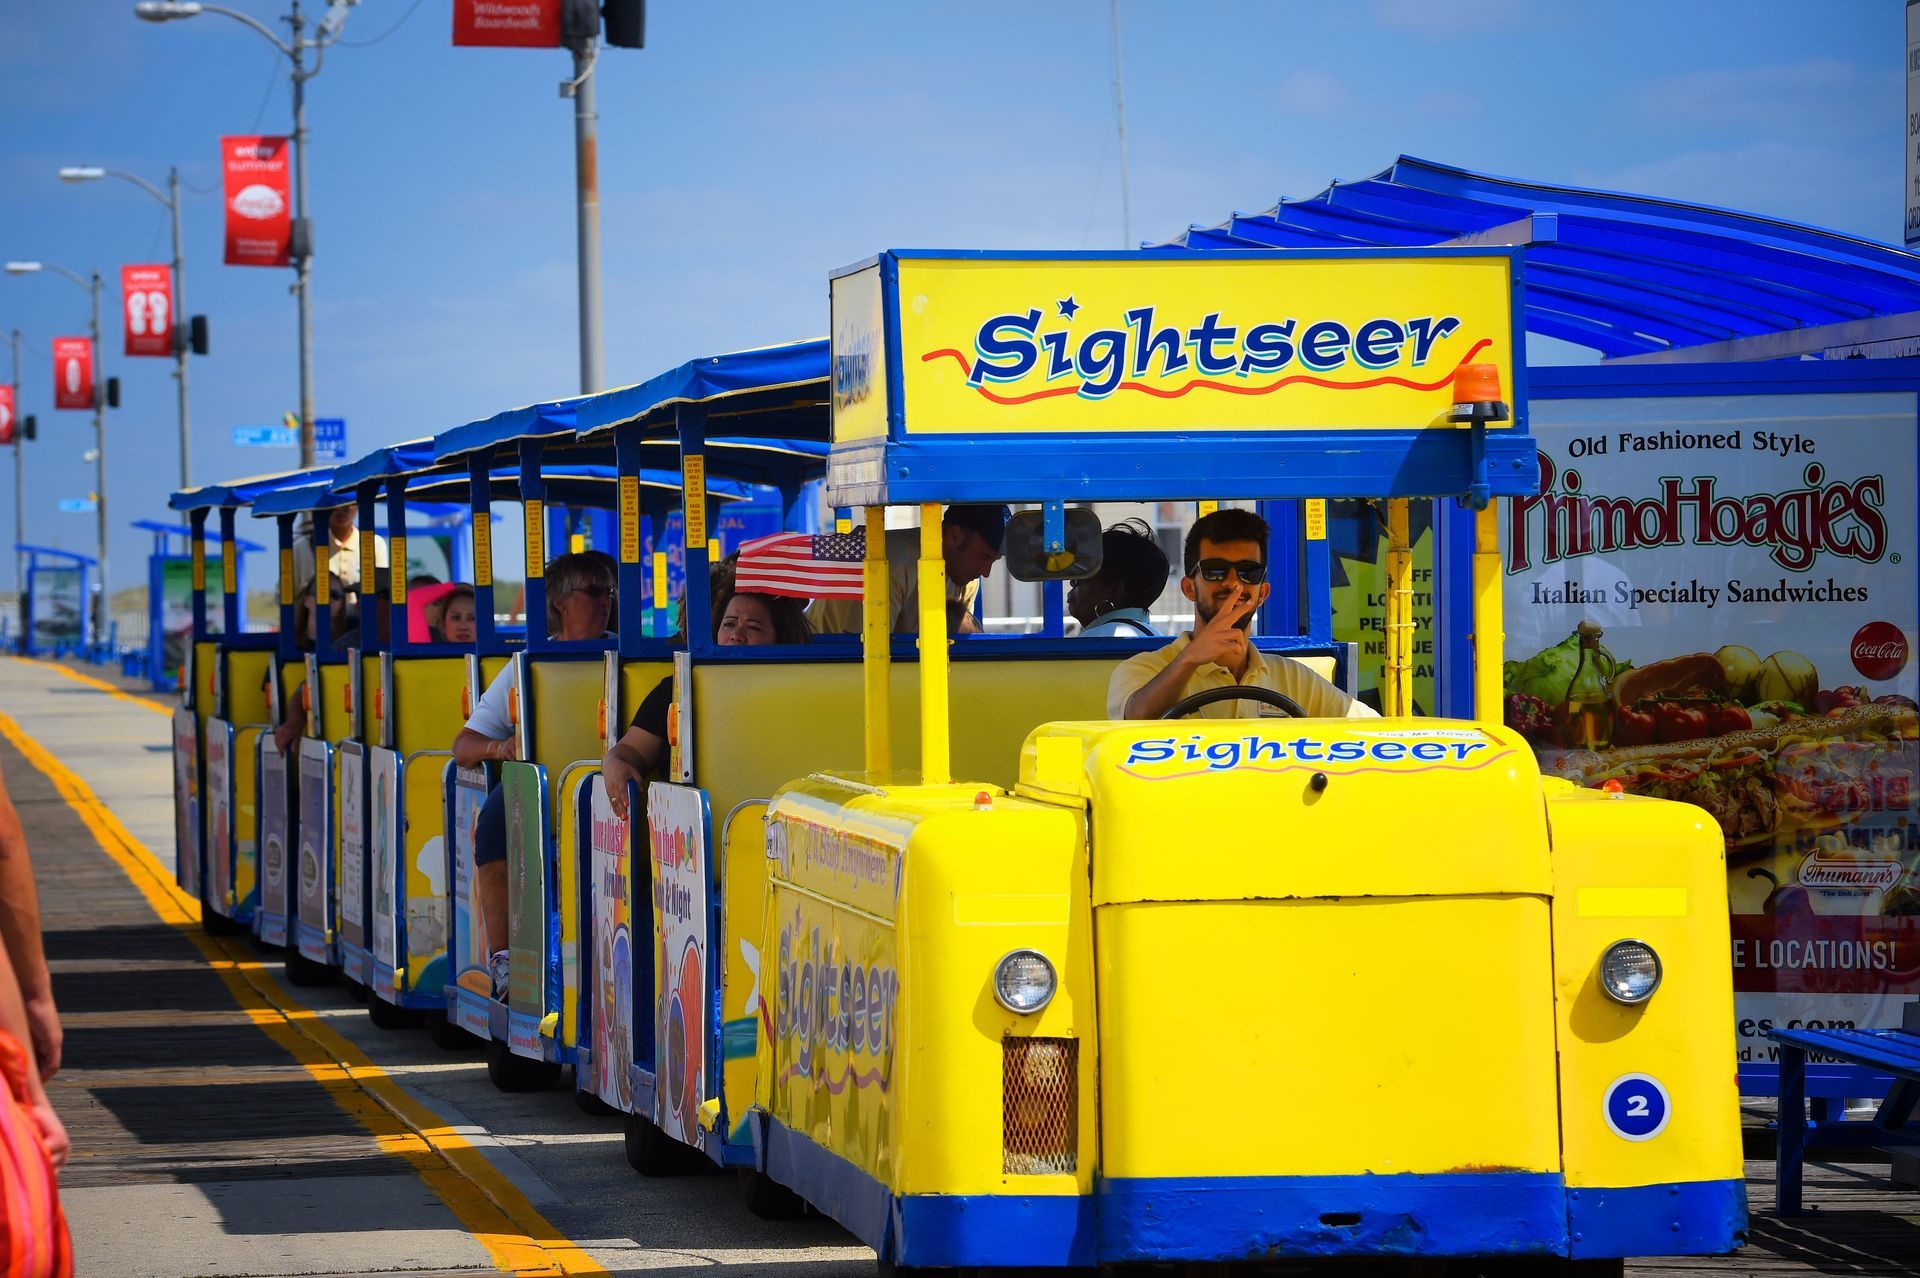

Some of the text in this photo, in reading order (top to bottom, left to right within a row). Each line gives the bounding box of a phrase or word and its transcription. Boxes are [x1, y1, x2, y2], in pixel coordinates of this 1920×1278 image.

[966, 296, 1461, 401] Sightseer
[1568, 430, 1815, 457] Old Fashioned Style
[1506, 447, 1888, 576] PrimoHoagies
[1531, 578, 1868, 610] Italian Specialty Sandwiches
[1126, 735, 1488, 770] Sightseer
[1803, 864, 1894, 883] Thumann's
[1755, 940, 1896, 970] LOCATIONS!
[776, 903, 898, 1079] Sightseer
[1626, 1095, 1650, 1117] 2
